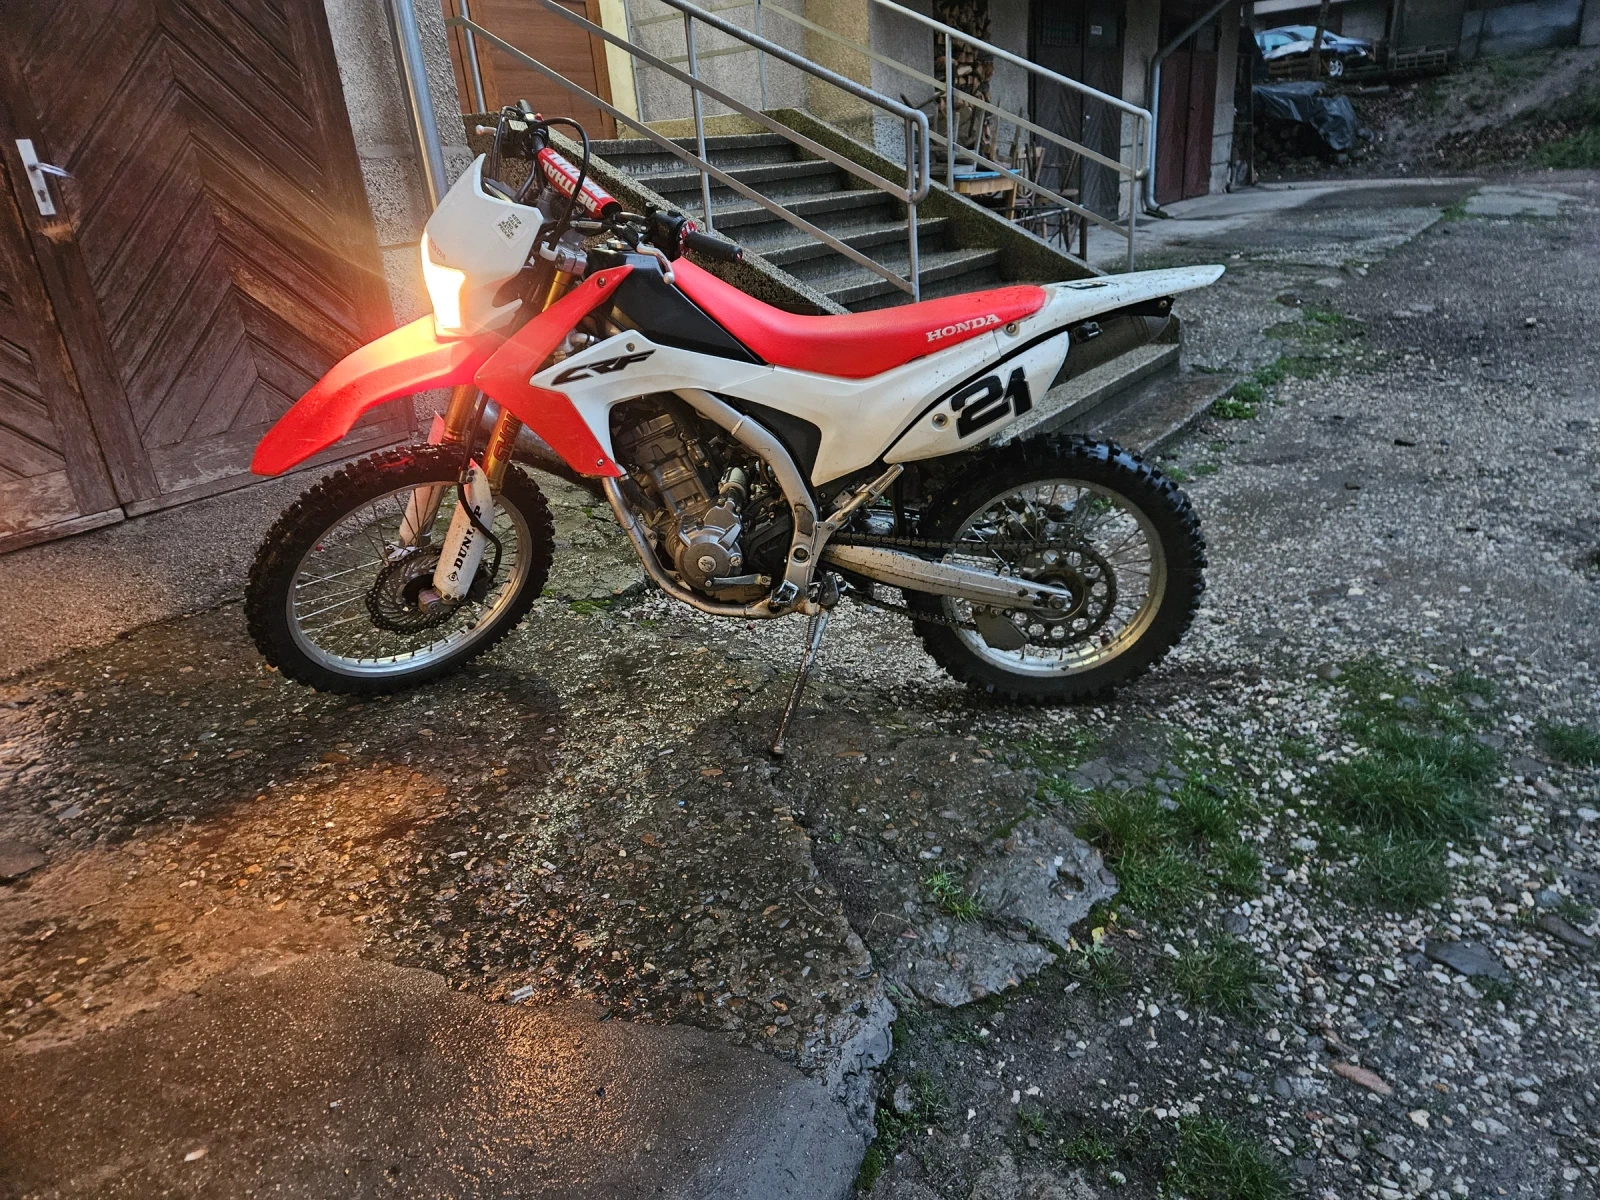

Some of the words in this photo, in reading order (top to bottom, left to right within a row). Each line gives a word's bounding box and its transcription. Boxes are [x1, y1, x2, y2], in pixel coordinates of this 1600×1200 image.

[925, 313, 1002, 342] HONDA
[550, 348, 657, 387] CRF
[950, 366, 1032, 440] 21
